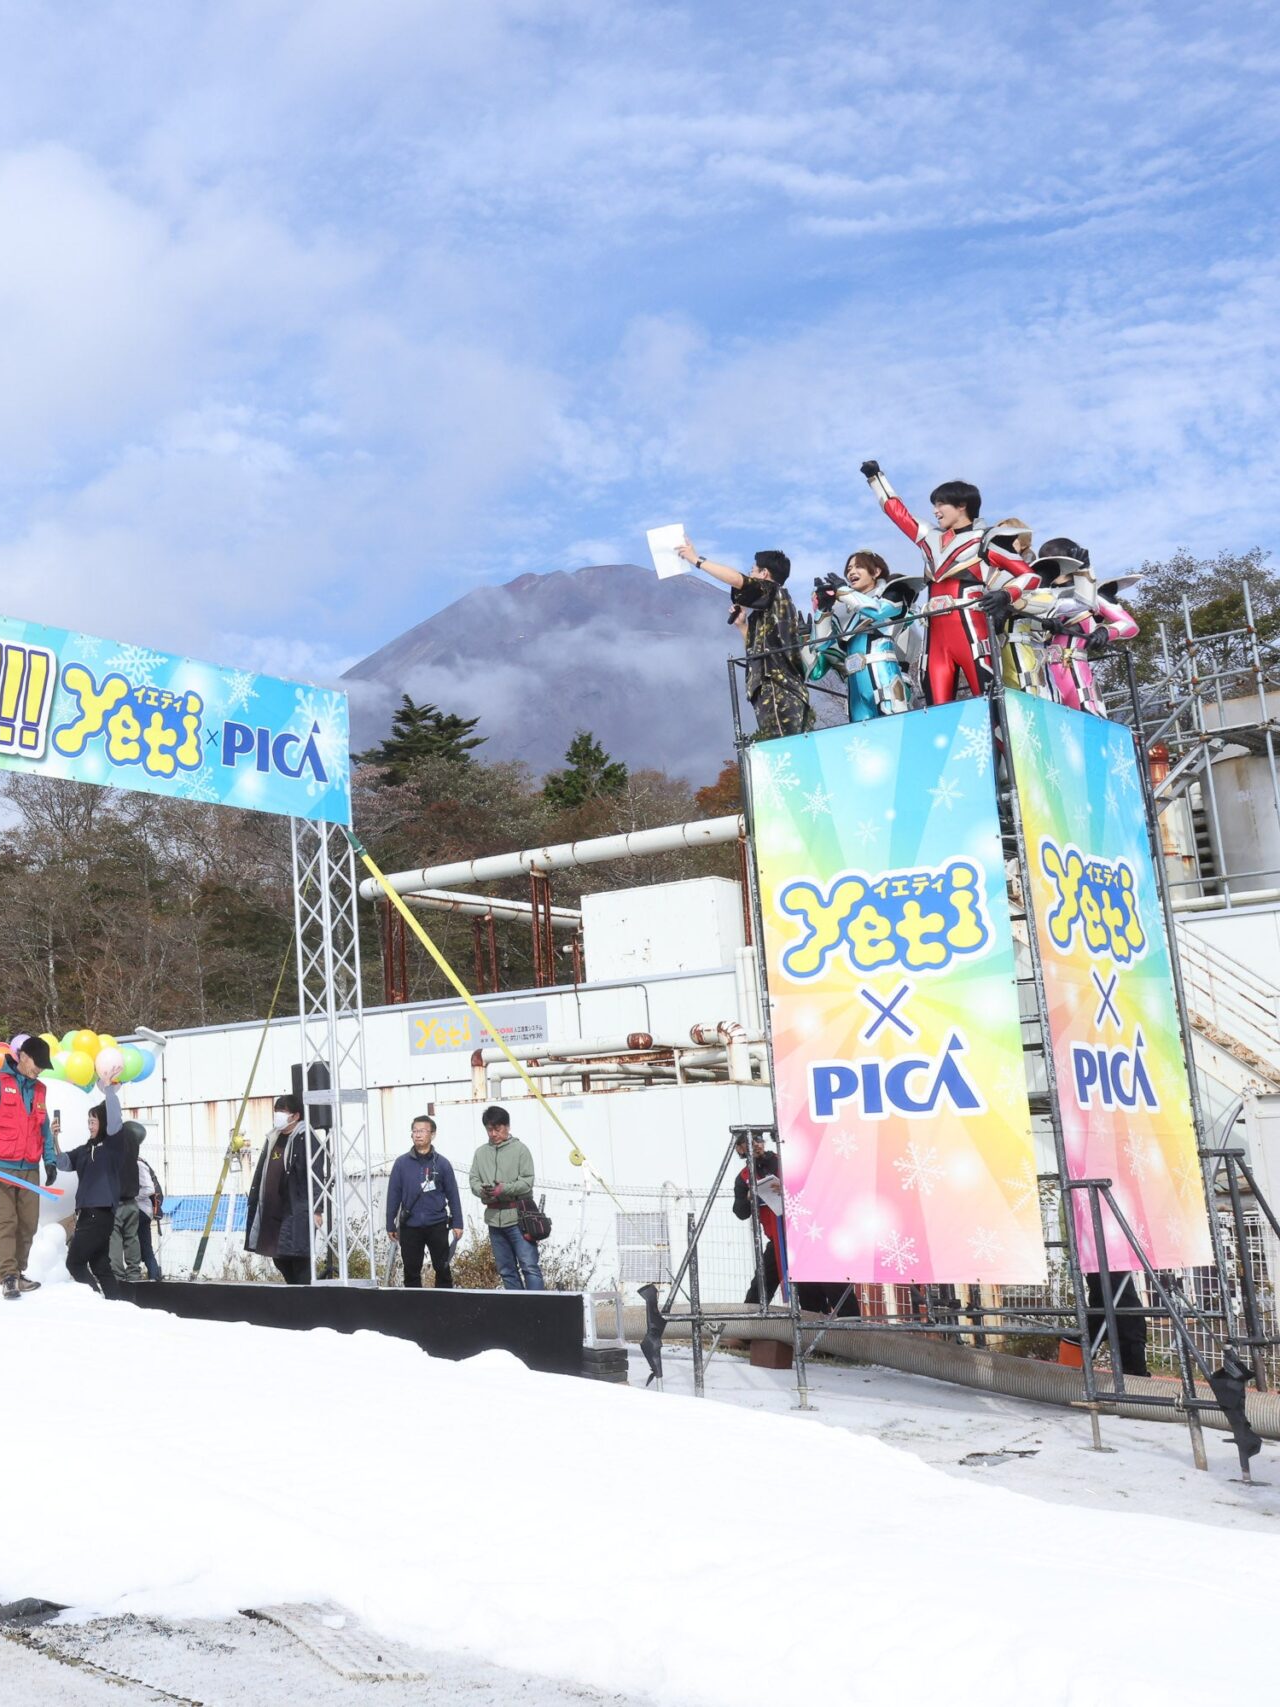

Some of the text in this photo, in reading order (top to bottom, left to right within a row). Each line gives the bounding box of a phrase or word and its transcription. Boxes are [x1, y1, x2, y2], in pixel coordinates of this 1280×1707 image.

[133, 687, 182, 712] イエティ
[873, 877, 944, 899] イエティ
[1086, 864, 1119, 889] イエティ
